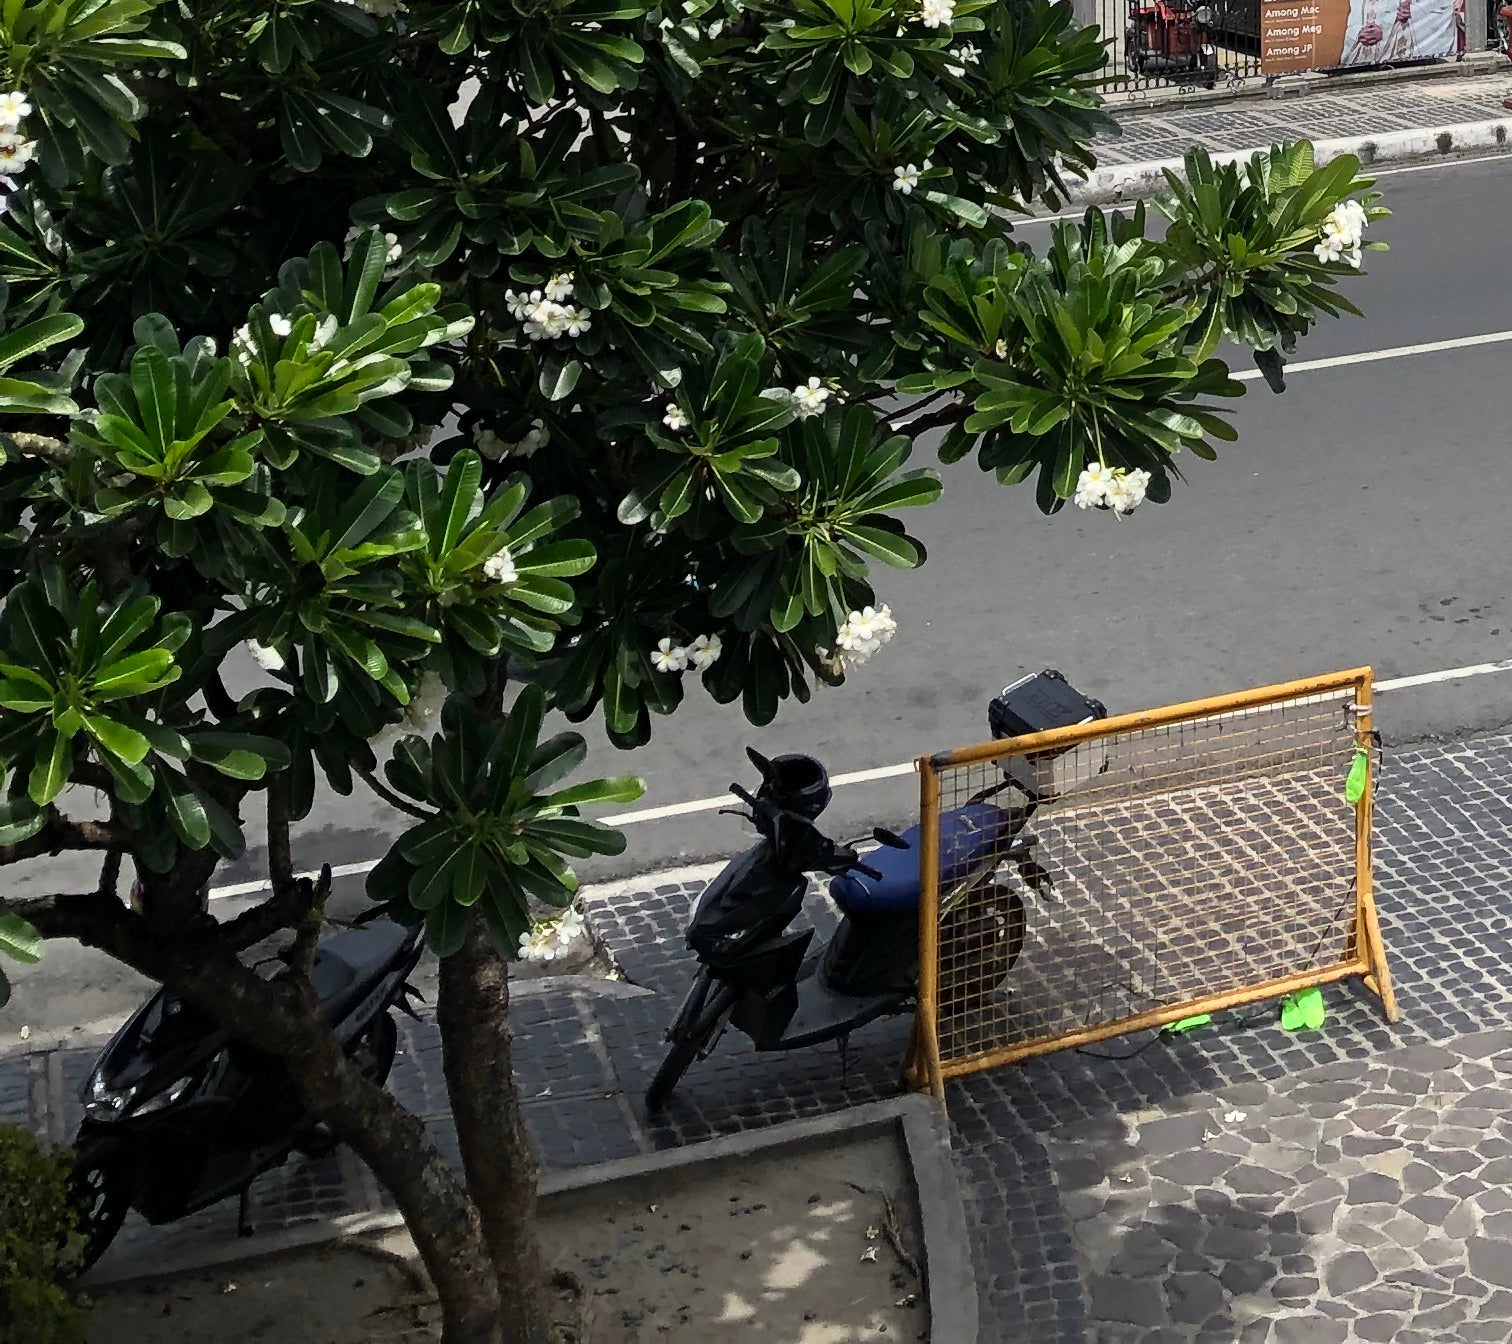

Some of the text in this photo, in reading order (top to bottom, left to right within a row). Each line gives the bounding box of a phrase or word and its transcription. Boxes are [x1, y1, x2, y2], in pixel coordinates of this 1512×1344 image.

[1265, 8, 1298, 18] Among
[1266, 24, 1322, 37] Among Meg
[1266, 43, 1313, 56] Among JP
